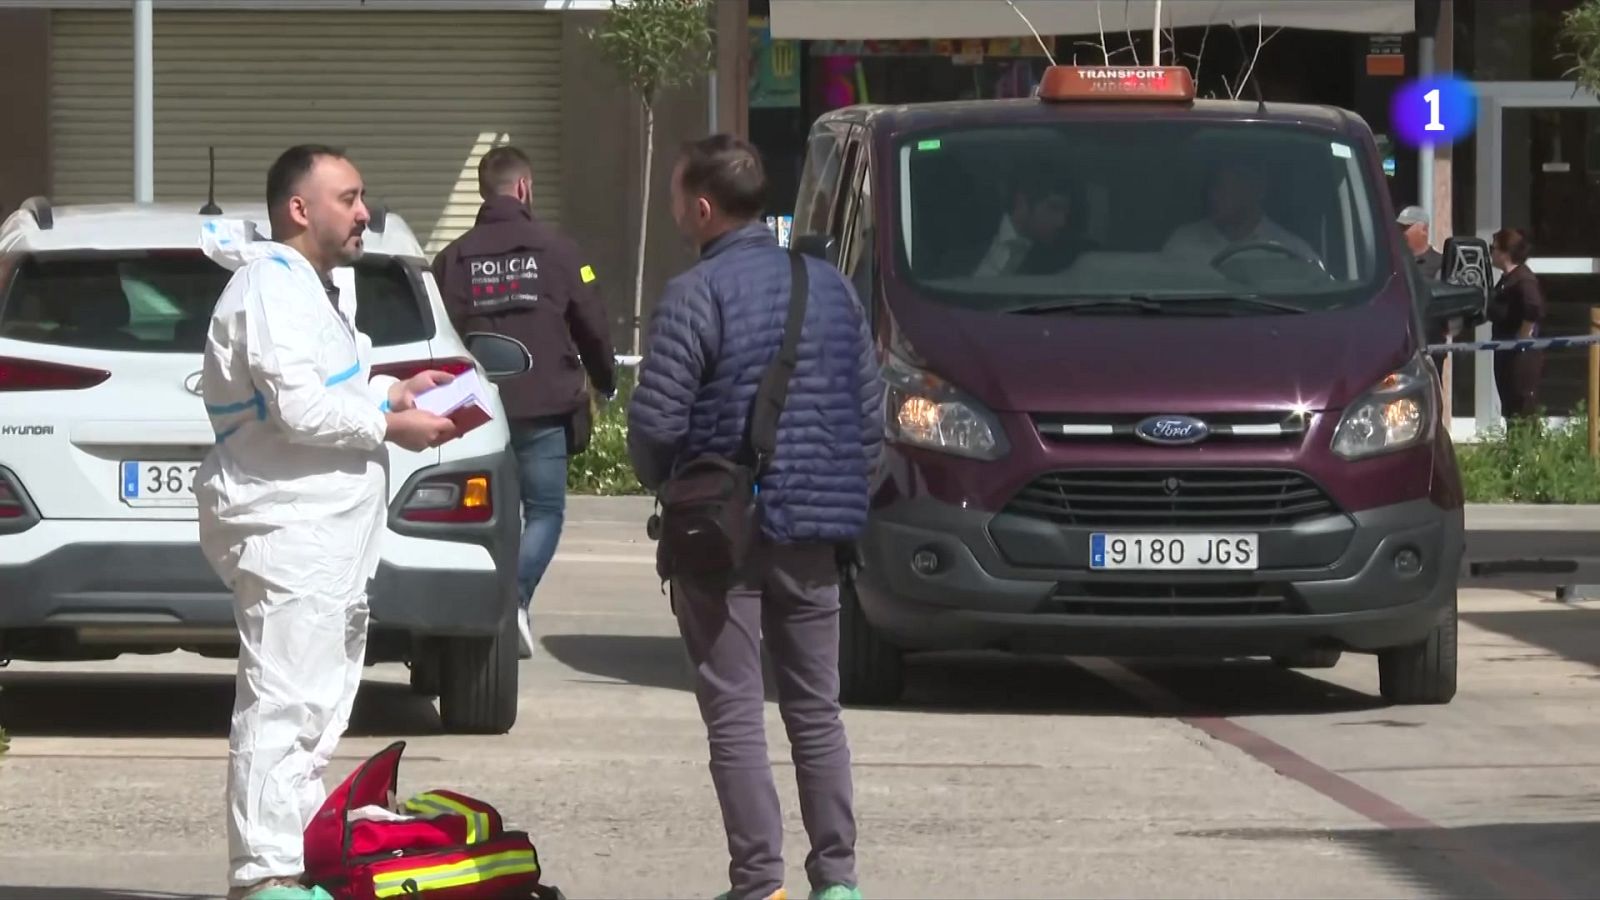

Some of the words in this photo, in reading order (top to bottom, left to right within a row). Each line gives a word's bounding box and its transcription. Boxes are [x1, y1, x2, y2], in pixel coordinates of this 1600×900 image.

[1077, 70, 1165, 79] TRANSPORT
[471, 256, 538, 275] POLICIA
[2, 425, 54, 435] HYUNDAI
[1153, 421, 1192, 437] Ford
[1111, 539, 1185, 564] 9180
[1197, 539, 1251, 564] JGS
